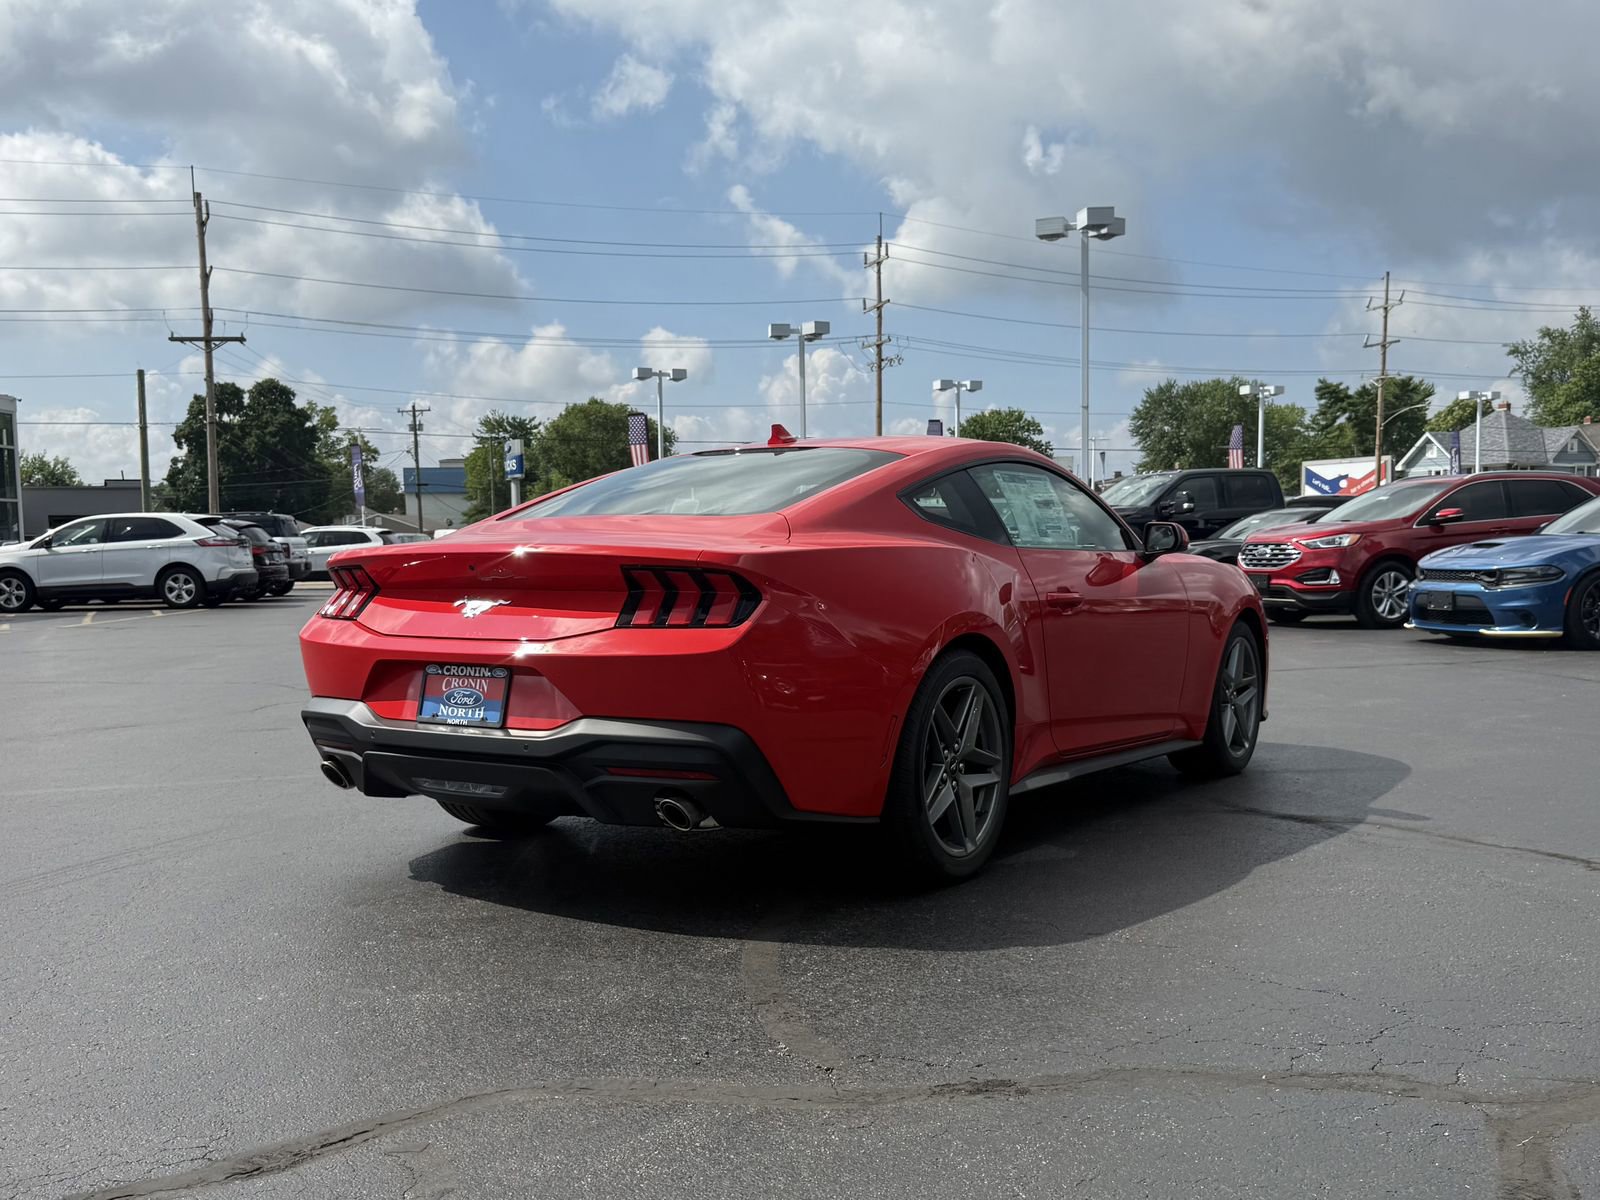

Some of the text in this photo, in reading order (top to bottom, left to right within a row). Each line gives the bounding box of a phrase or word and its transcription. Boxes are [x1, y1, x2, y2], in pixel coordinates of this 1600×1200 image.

[443, 665, 489, 677] CRONIN
[442, 677, 489, 693] CRONIN
[450, 690, 477, 705] Ford
[438, 703, 486, 719] NORTH
[446, 718, 468, 726] NORTH
